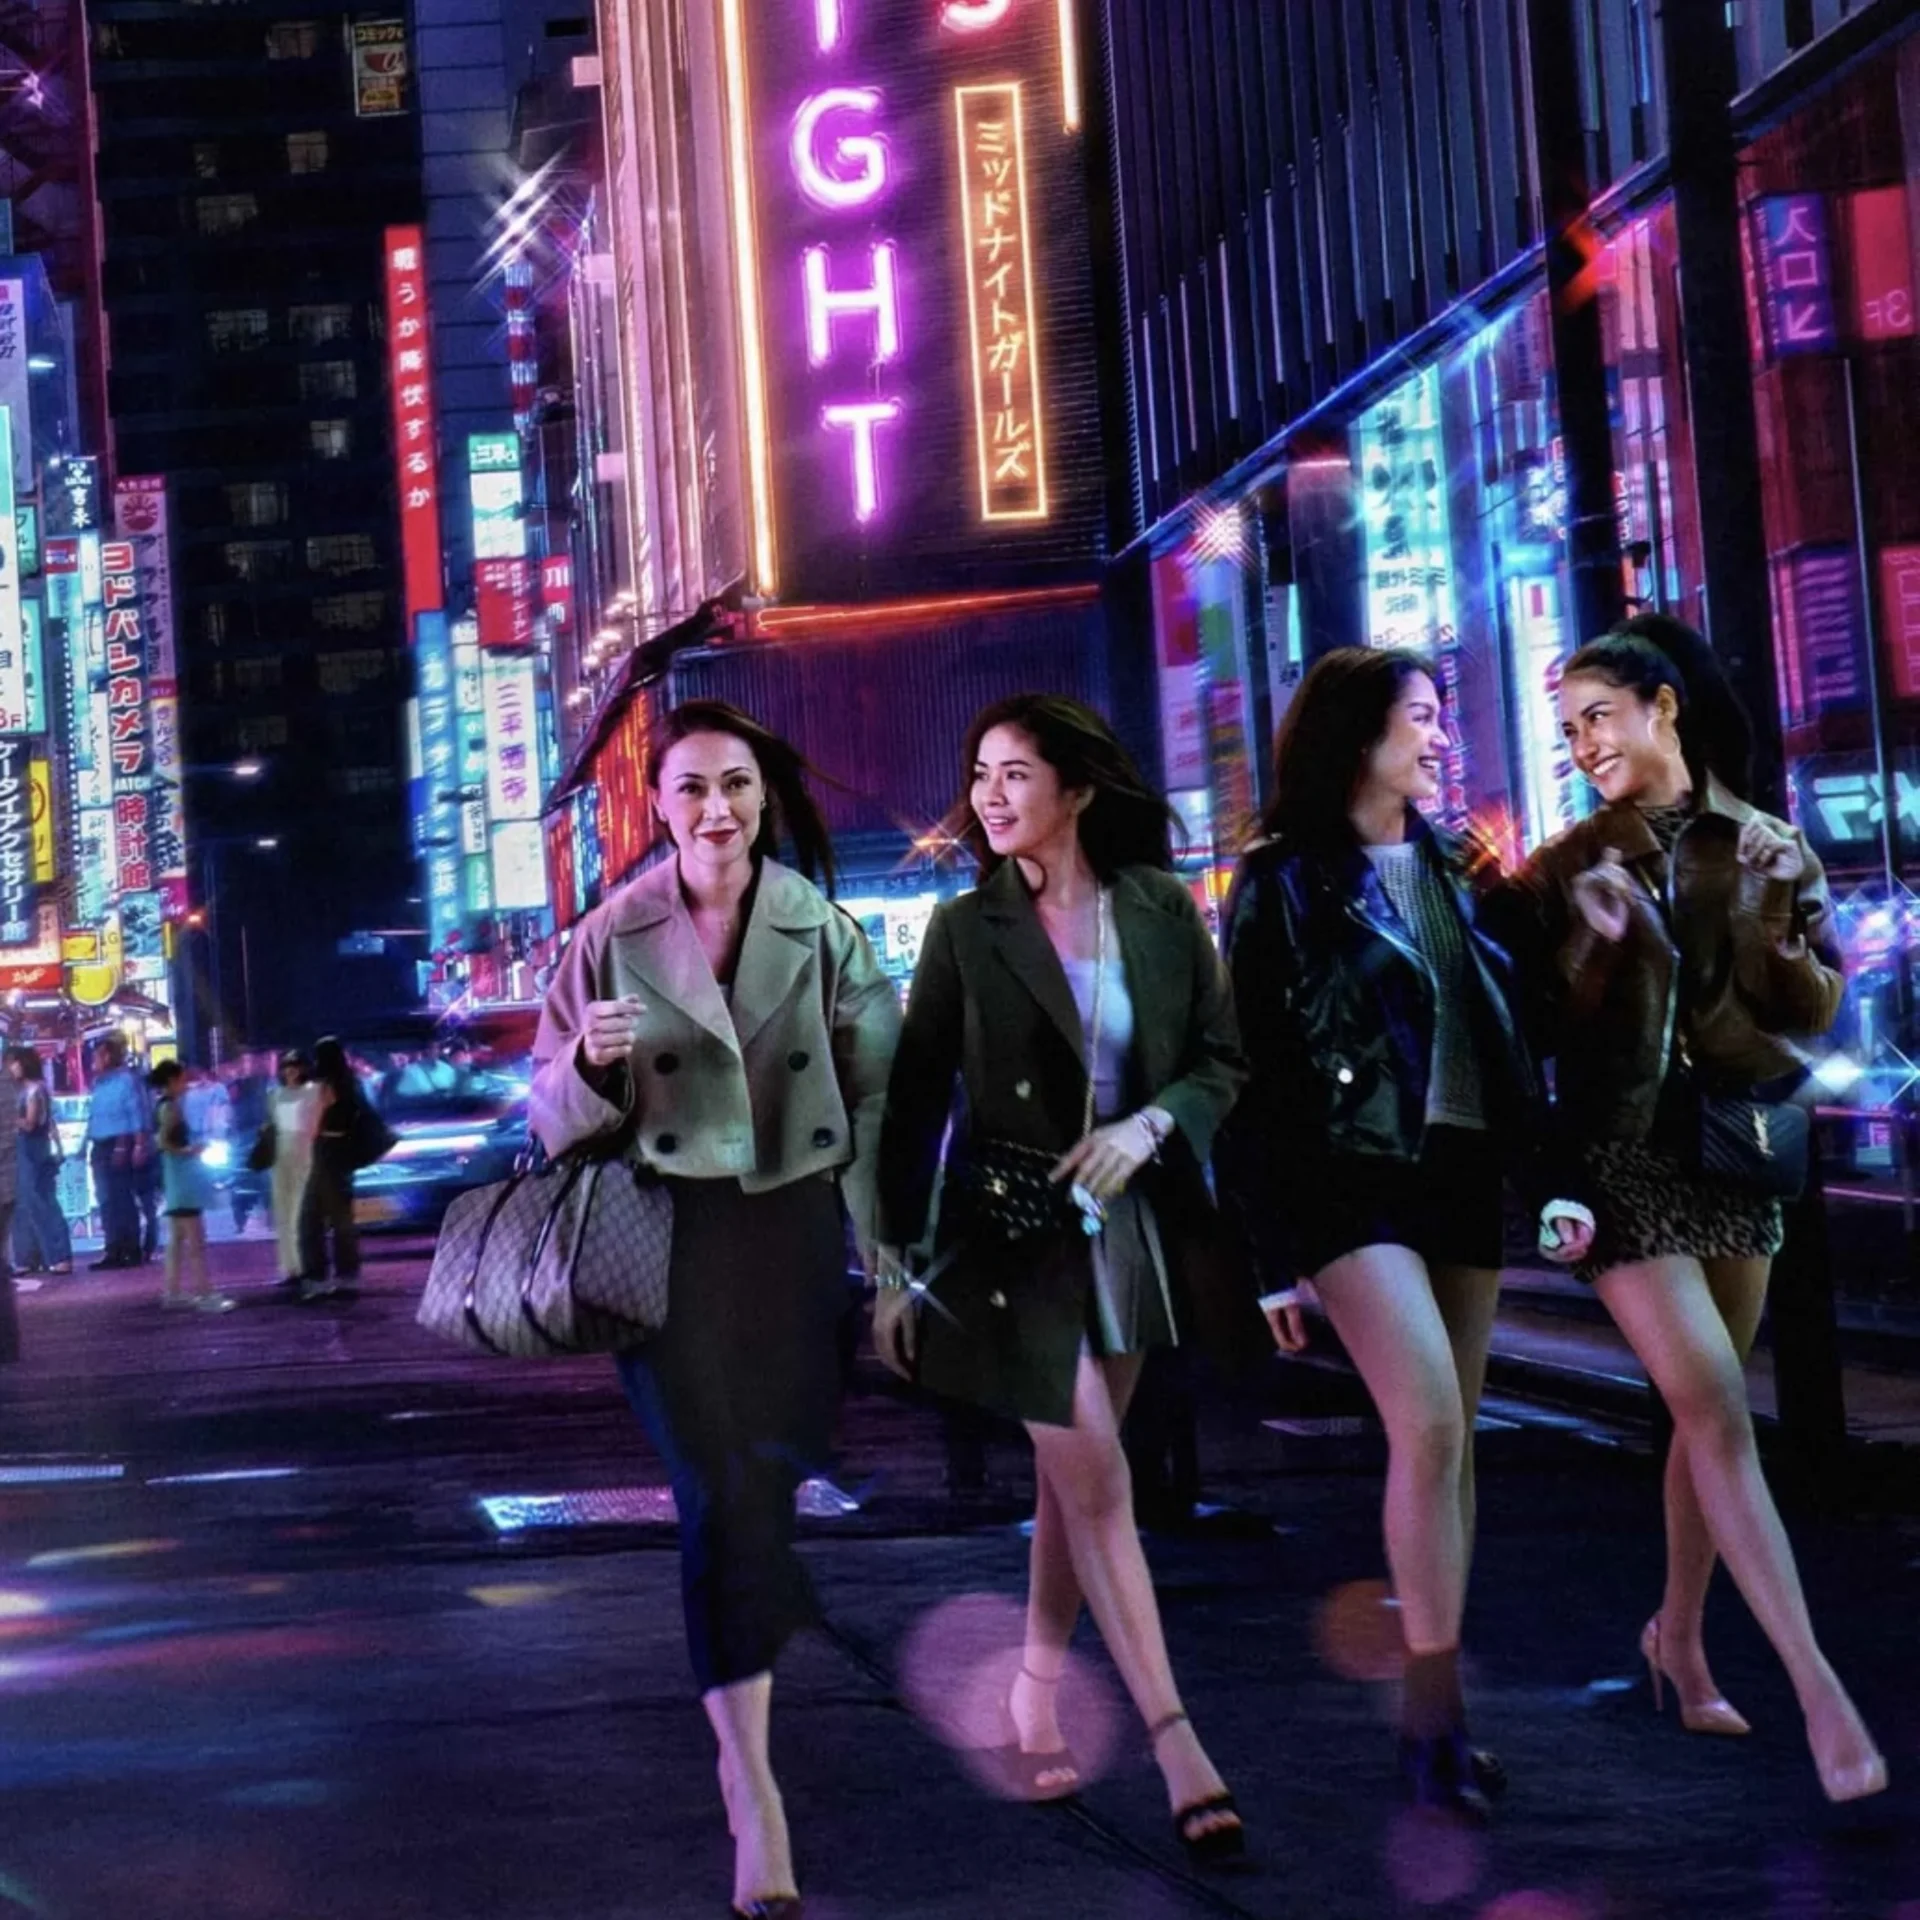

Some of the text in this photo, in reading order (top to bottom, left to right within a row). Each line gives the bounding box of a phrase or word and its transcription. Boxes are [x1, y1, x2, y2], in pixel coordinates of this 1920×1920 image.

[976, 121, 1034, 481] ミッドナイトガールズ
[101, 541, 145, 773] ヨドバシカメラ
